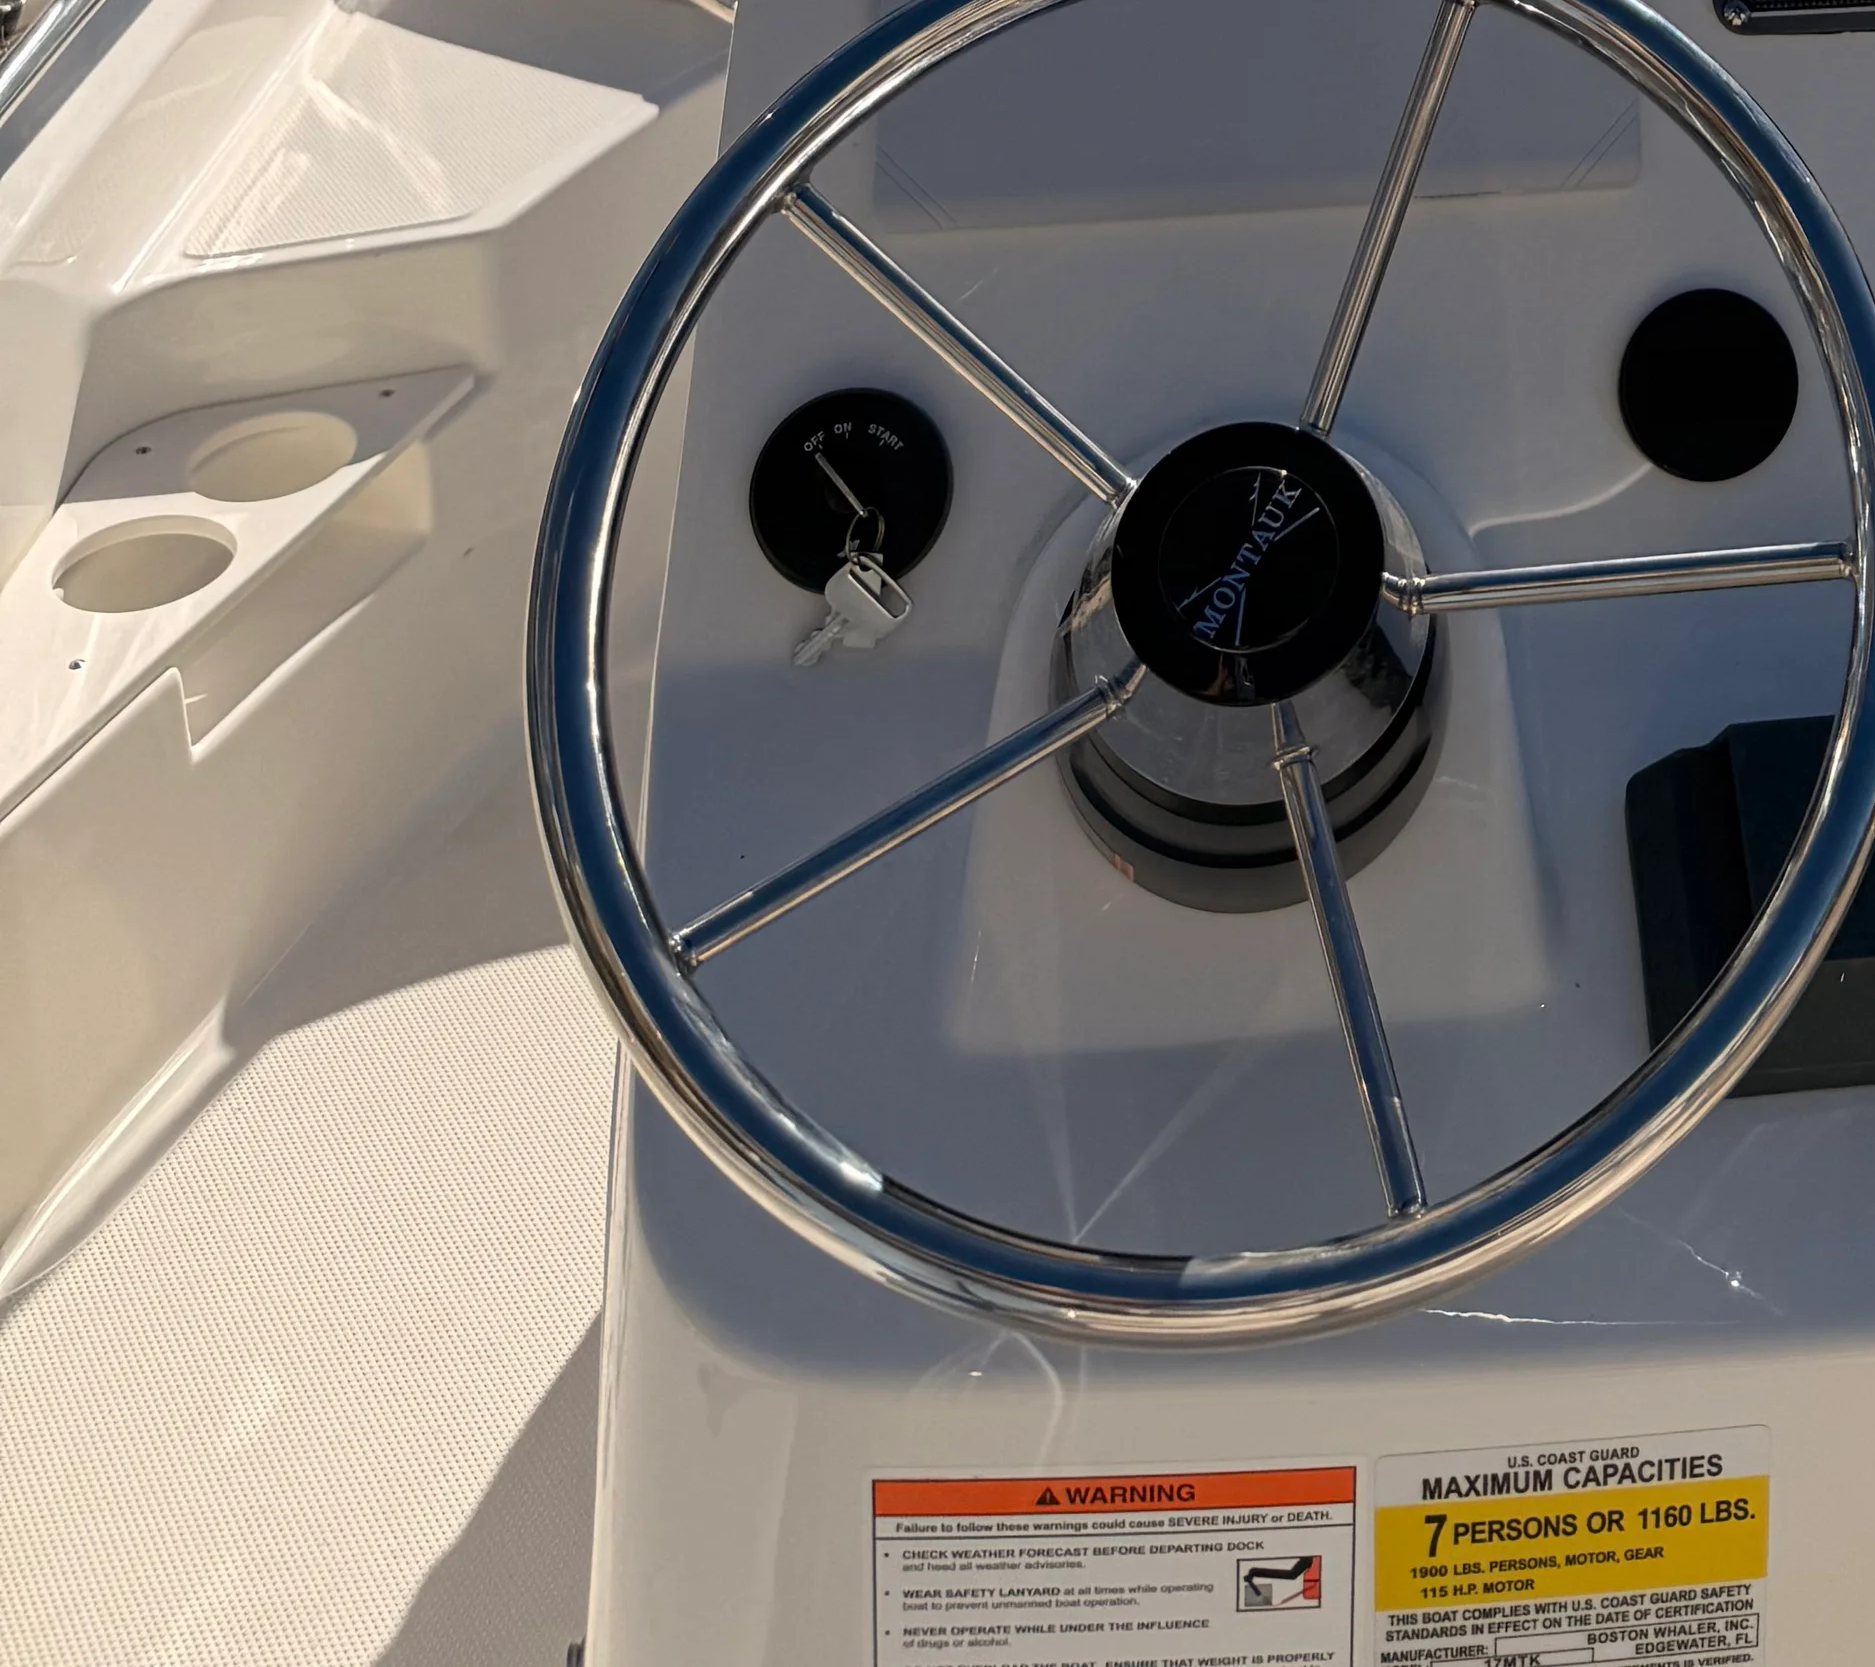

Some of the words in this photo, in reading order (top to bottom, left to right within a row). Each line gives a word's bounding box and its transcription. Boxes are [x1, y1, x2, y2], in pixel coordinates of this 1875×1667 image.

[834, 423, 852, 435] ON
[868, 423, 904, 451] START
[804, 431, 826, 451] OFF
[1192, 480, 1302, 638] MONTAUK
[1508, 1456, 1532, 1469] U.S.
[1537, 1451, 1585, 1466] COAST
[1590, 1447, 1639, 1461] GUARD
[1422, 1469, 1552, 1500] MAXIMUM
[1564, 1454, 1722, 1489] CAPACITIES
[1065, 1483, 1195, 1505] WARNING
[896, 1523, 937, 1532] Failure
[941, 1523, 952, 1532] to
[957, 1523, 993, 1532] follow
[997, 1523, 1029, 1531] these
[1033, 1523, 1088, 1531] warnings
[1092, 1519, 1125, 1529] could
[1169, 1516, 1218, 1527] SEVERE
[1223, 1514, 1268, 1525] INJURY
[1271, 1515, 1284, 1523] or
[1424, 1514, 1447, 1558] 7
[1454, 1514, 1577, 1545] PERSONS
[1587, 1510, 1624, 1534] OR
[1638, 1505, 1692, 1529] 1160
[1700, 1499, 1755, 1523] LBS.
[902, 1551, 948, 1559] CHECK
[951, 1549, 1015, 1559] WEATHER
[1019, 1548, 1088, 1557] FORECAST
[1093, 1546, 1145, 1556] BEFORE
[1150, 1543, 1223, 1554] DEPARTING
[1227, 1541, 1264, 1551] DOCK
[1411, 1565, 1448, 1579] 1900
[1454, 1563, 1485, 1575] LBS.
[1490, 1556, 1560, 1573] PERSONS,
[1565, 1551, 1620, 1566] MOTOR,
[1624, 1547, 1664, 1561] GEAR
[903, 1590, 942, 1598] WEAR
[946, 1589, 995, 1598] SAFETY
[999, 1587, 1060, 1597] LANYARD
[1064, 1587, 1074, 1595] at
[1078, 1587, 1091, 1595] all
[1094, 1587, 1125, 1595] times
[1128, 1585, 1157, 1593] while
[1160, 1583, 1214, 1593] operating
[1421, 1586, 1448, 1599] 115
[1453, 1583, 1478, 1596] H.P.
[1483, 1579, 1534, 1593] MOTOR
[1388, 1614, 1418, 1626] THIS
[1422, 1610, 1458, 1624] BOAT
[1462, 1605, 1530, 1621] COMPLIES
[1534, 1601, 1567, 1614] WITH
[1572, 1599, 1596, 1612] U.S.
[1601, 1594, 1646, 1609] COAST
[1650, 1589, 1697, 1604] GUARD
[1701, 1584, 1751, 1599] SAFETY
[904, 1627, 946, 1636] NEVER
[951, 1625, 1010, 1635] OPERATE
[1015, 1625, 1055, 1633] WHILE
[1060, 1623, 1104, 1633] UNDER
[1109, 1623, 1132, 1631] THE
[1137, 1619, 1209, 1630] INFLUENCE
[1386, 1625, 1467, 1642] STANDARDS
[1472, 1624, 1484, 1635] IN
[1488, 1619, 1539, 1634] EFFECT
[1542, 1617, 1562, 1629] ON
[1566, 1614, 1591, 1627] THE
[1596, 1611, 1629, 1624] DATE
[1634, 1609, 1651, 1621] OF
[1655, 1599, 1753, 1619] CERTIFICATION
[1588, 1629, 1648, 1645] BOSTON
[1725, 1619, 1753, 1631] INC.
[1736, 1633, 1752, 1645] FL
[1380, 1645, 1488, 1663] MANUFACTURER:
